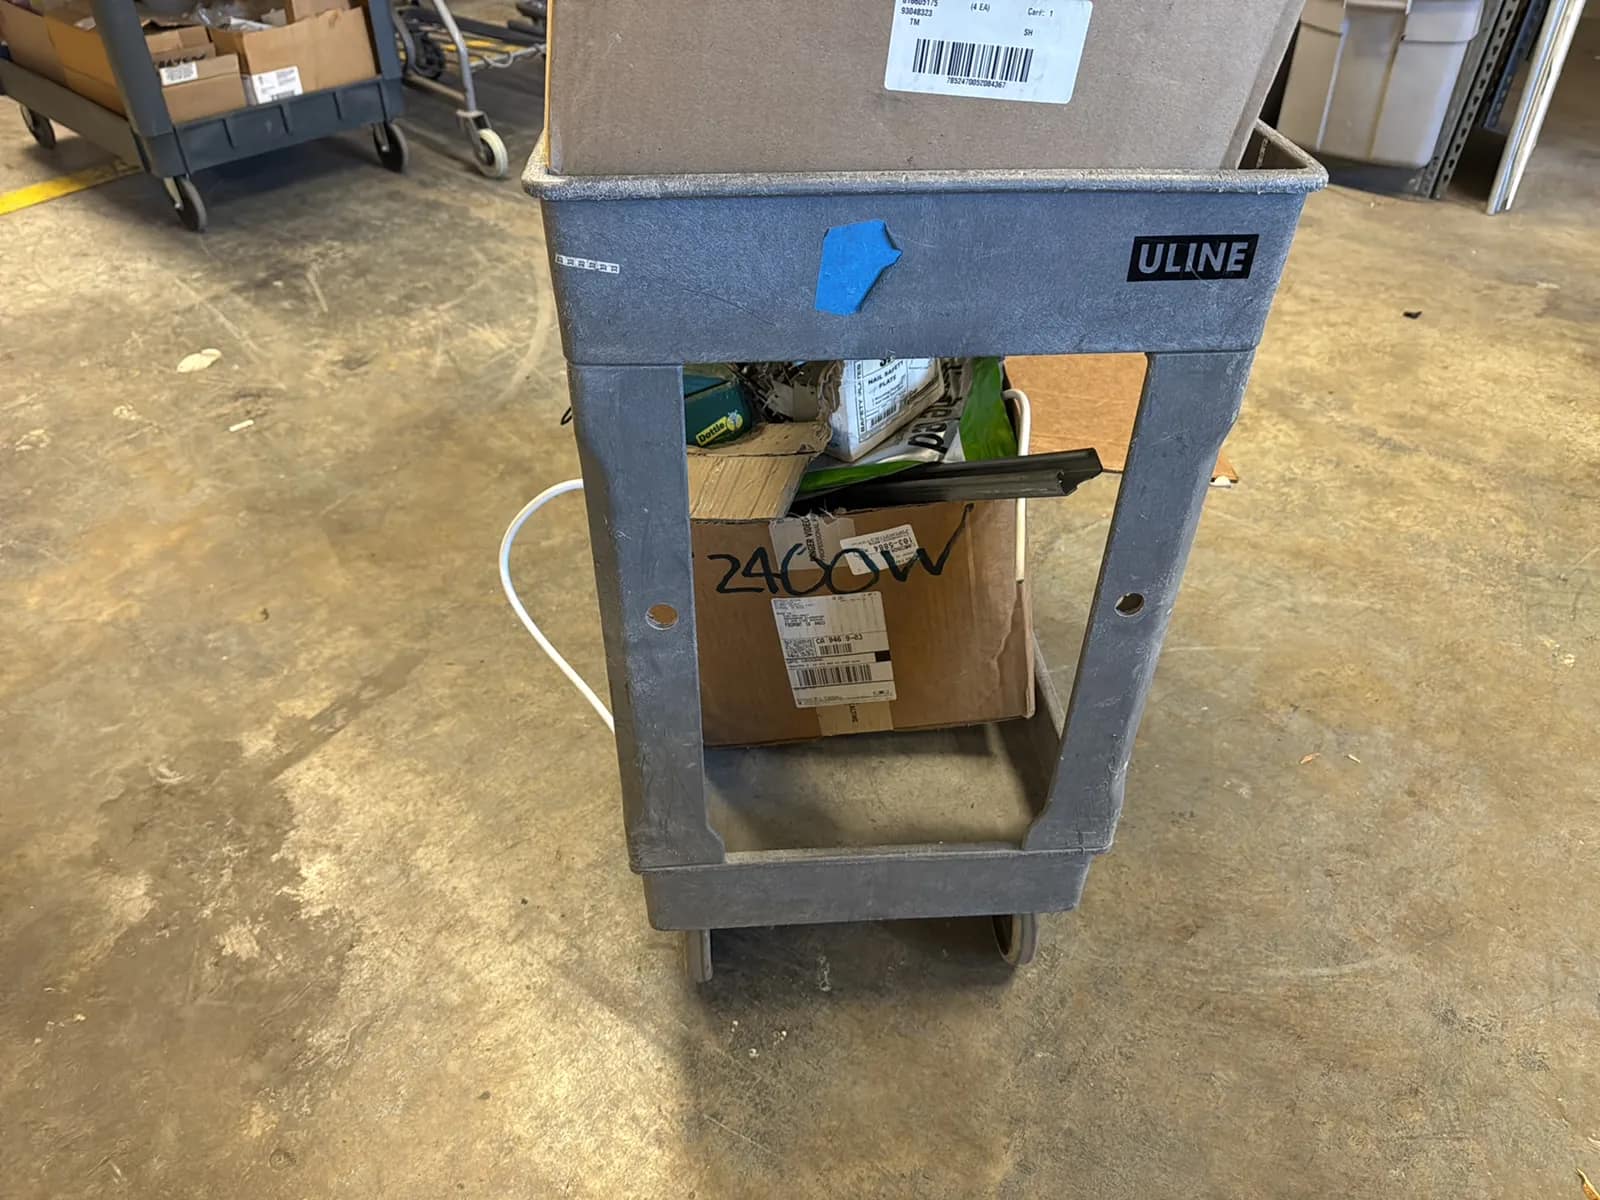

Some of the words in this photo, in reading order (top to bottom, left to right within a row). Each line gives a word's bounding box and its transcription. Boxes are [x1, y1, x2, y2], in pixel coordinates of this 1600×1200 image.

[979, 3, 990, 12] EA)
[910, 17, 920, 26] TM
[1023, 28, 1034, 37] SH
[1138, 242, 1248, 273] ULINE
[868, 374, 882, 385] NAIL
[884, 360, 904, 376] SAFETY
[698, 423, 725, 442] Dottle
[707, 503, 974, 595] 2400W
